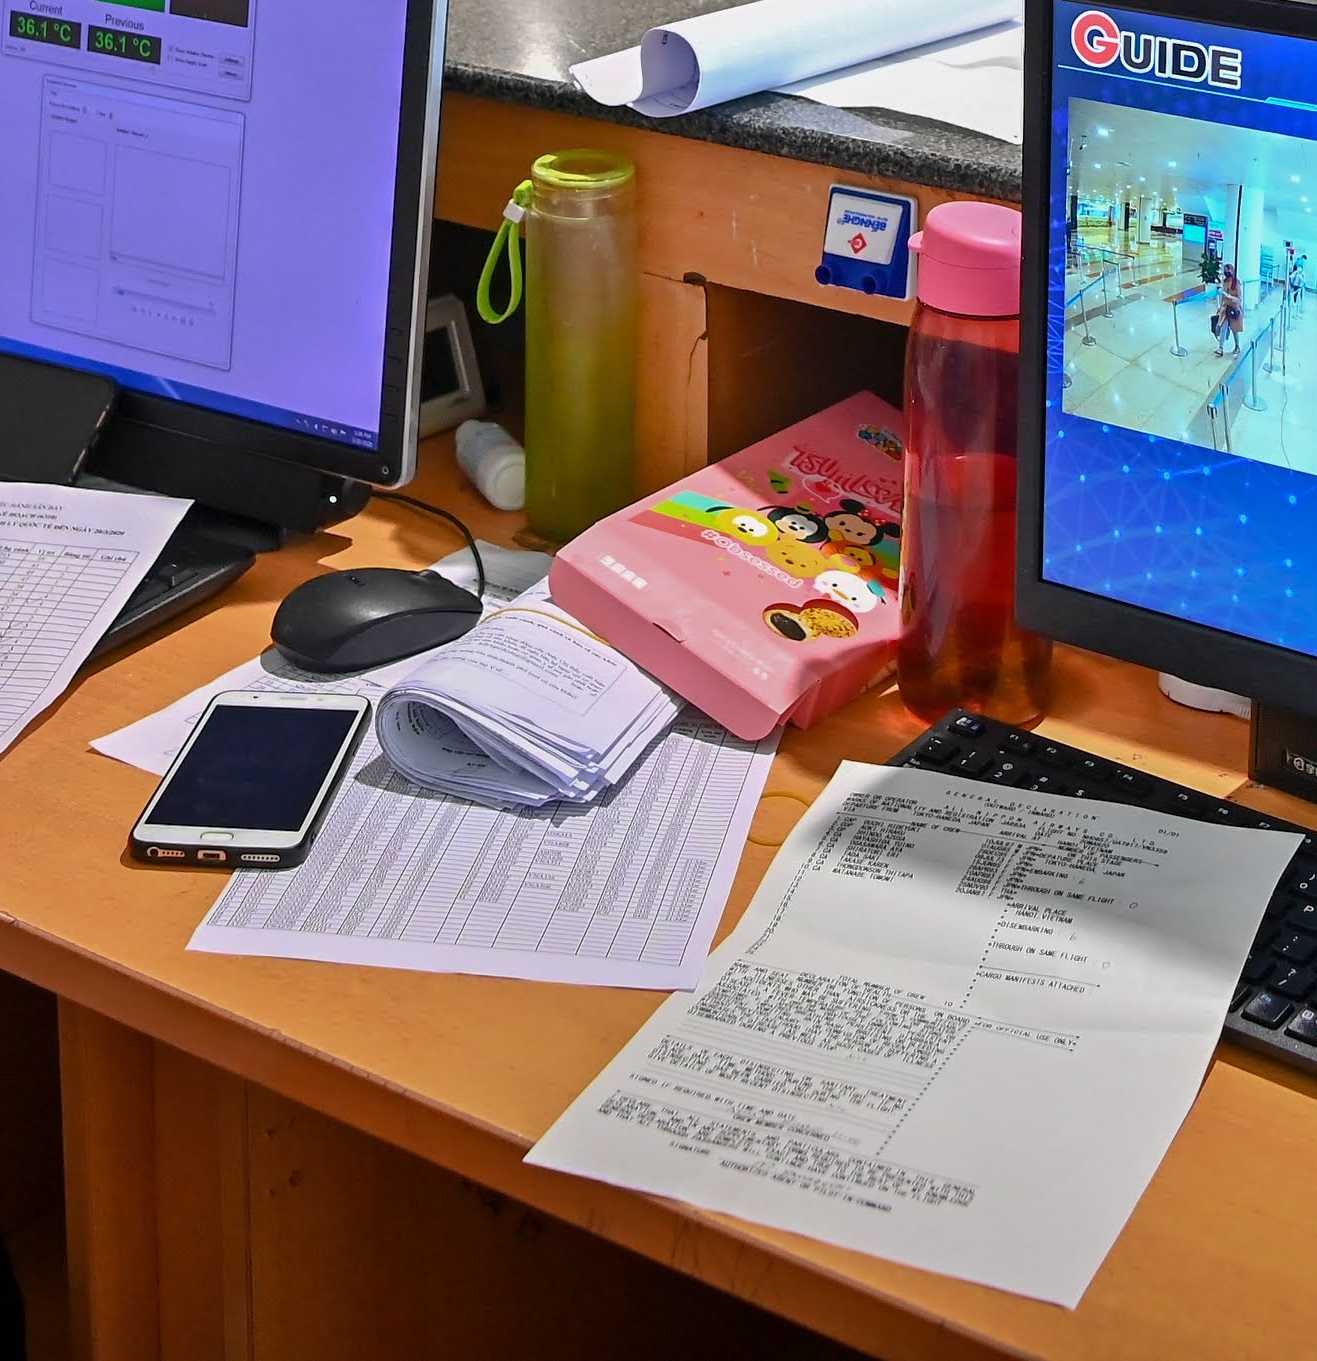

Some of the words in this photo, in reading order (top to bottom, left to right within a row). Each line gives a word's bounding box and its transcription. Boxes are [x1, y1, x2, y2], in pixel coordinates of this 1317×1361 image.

[29, 0, 63, 16] Current
[17, 17, 47, 38] 36.1
[105, 13, 145, 31] Previous
[95, 31, 126, 52] 36.1
[1071, 10, 1242, 90] GUIDE
[700, 529, 804, 589] #Obsessed
